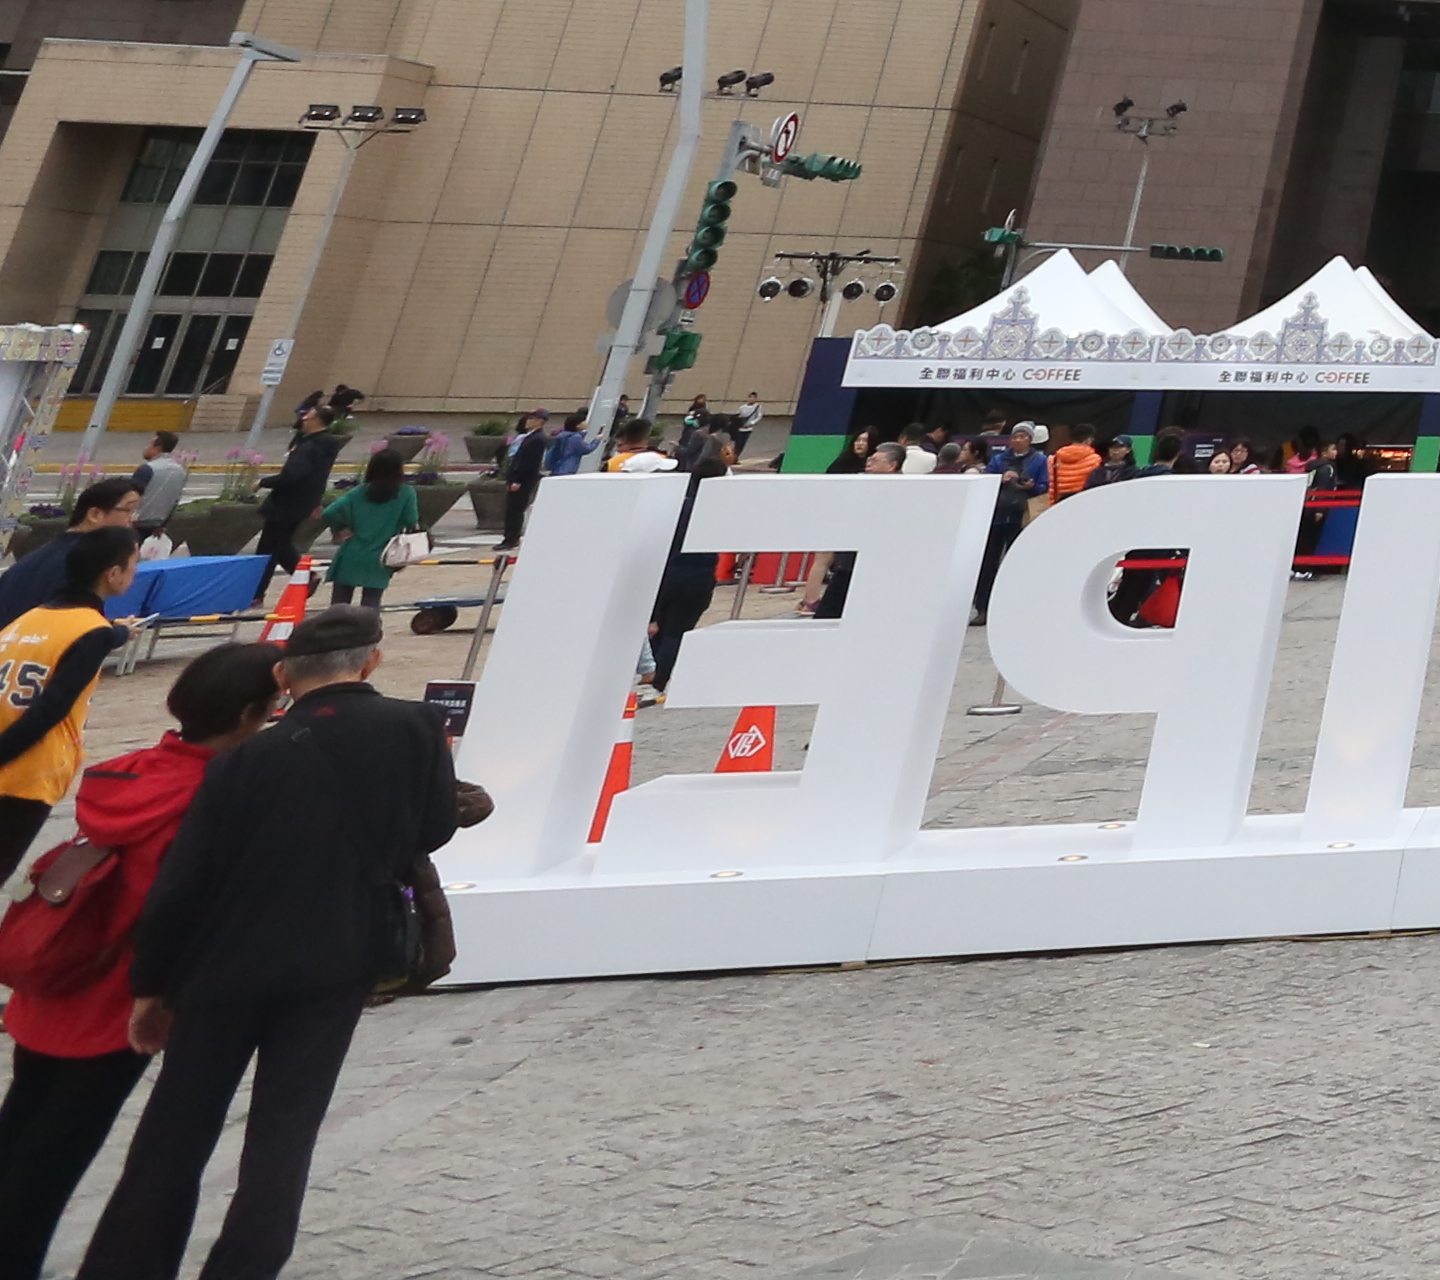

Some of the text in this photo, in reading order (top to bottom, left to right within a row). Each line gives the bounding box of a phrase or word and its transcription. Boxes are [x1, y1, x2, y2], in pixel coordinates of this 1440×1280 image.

[919, 367, 1083, 382] 全聯福利中心 COFFEE
[1218, 370, 1370, 385] 全聯福利中心 COFFEE
